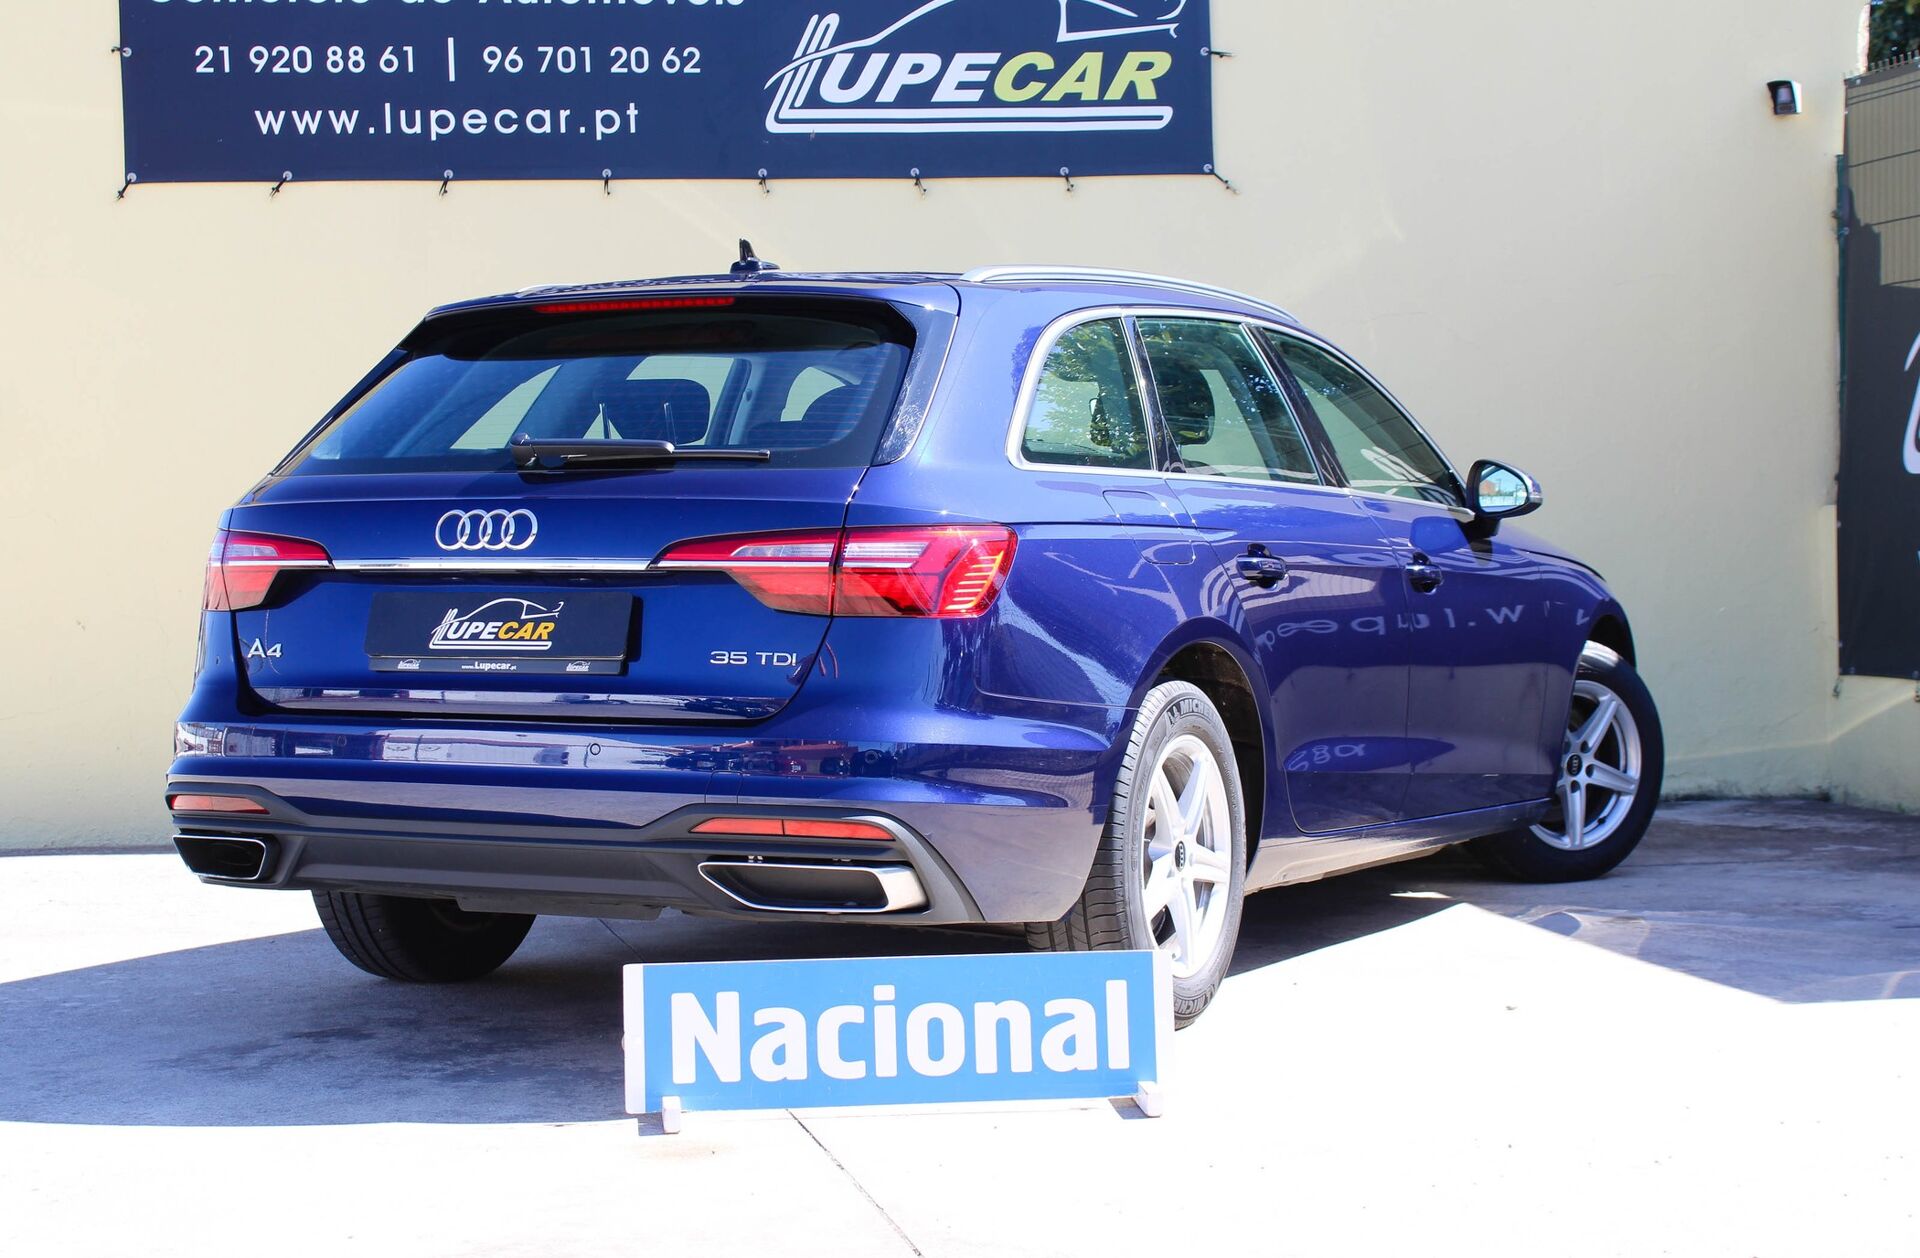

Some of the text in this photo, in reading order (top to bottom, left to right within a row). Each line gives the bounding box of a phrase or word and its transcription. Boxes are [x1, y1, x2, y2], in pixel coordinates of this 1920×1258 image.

[195, 45, 701, 74] 21 920 88 61 96 701 20 62
[254, 102, 639, 141] www.lupecar.pt
[247, 637, 282, 658] A4
[709, 650, 797, 667] 35 TDI
[670, 979, 1130, 1083] Nacional
